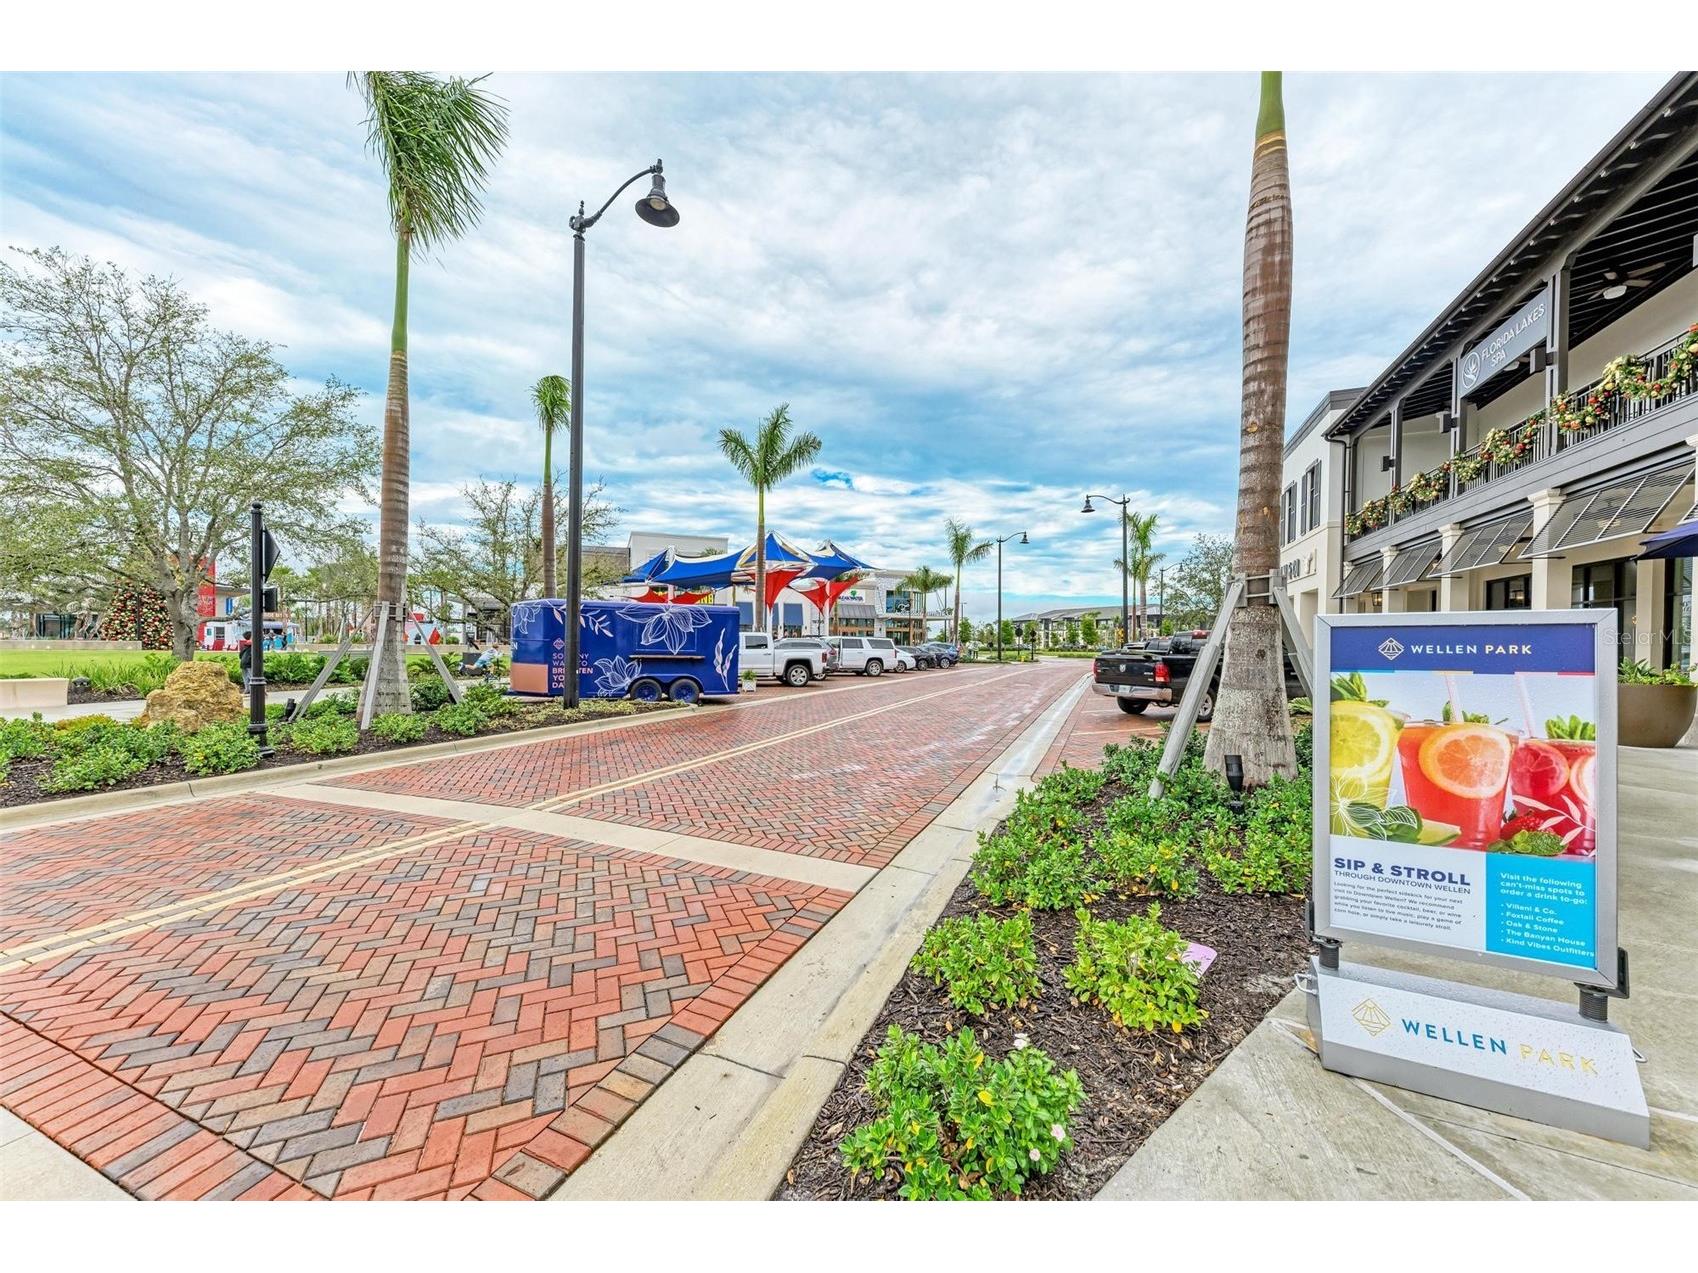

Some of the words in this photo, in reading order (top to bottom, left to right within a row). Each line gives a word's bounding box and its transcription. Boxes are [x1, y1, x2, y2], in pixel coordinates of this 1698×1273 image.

[1481, 328, 1516, 360] FLORIDA
[1516, 304, 1544, 336] LAKES
[1491, 350, 1507, 366] SPA
[1411, 644, 1477, 654] WELLEN
[1485, 644, 1532, 654] PARK
[1334, 857, 1366, 870] SIP
[1371, 862, 1384, 875] &
[1390, 865, 1471, 886] STROLL
[1335, 870, 1376, 881] THROUGH
[1378, 876, 1432, 890] DOWNTOWN
[1434, 884, 1471, 894] WELLEN
[1500, 872, 1521, 881] Visit
[1522, 875, 1537, 883] the
[1540, 876, 1582, 890] following
[1500, 880, 1546, 892] can't-miss
[1548, 886, 1573, 896] spots
[1500, 888, 1524, 896] order
[1534, 892, 1558, 901] drink
[1534, 905, 1540, 913] &
[1506, 911, 1534, 921] Foxtail
[1536, 915, 1564, 926] Coffee
[1506, 920, 1522, 928] Oak
[1534, 924, 1558, 934] Stone
[1506, 928, 1522, 937] The
[1524, 931, 1556, 942] Banyan
[1558, 937, 1586, 947] House
[1506, 938, 1525, 946] Kind
[1527, 941, 1551, 950] Vibes
[1553, 945, 1594, 958] Outfitters
[1402, 1018, 1507, 1055] WELLEN
[1518, 1044, 1598, 1075] PARK
